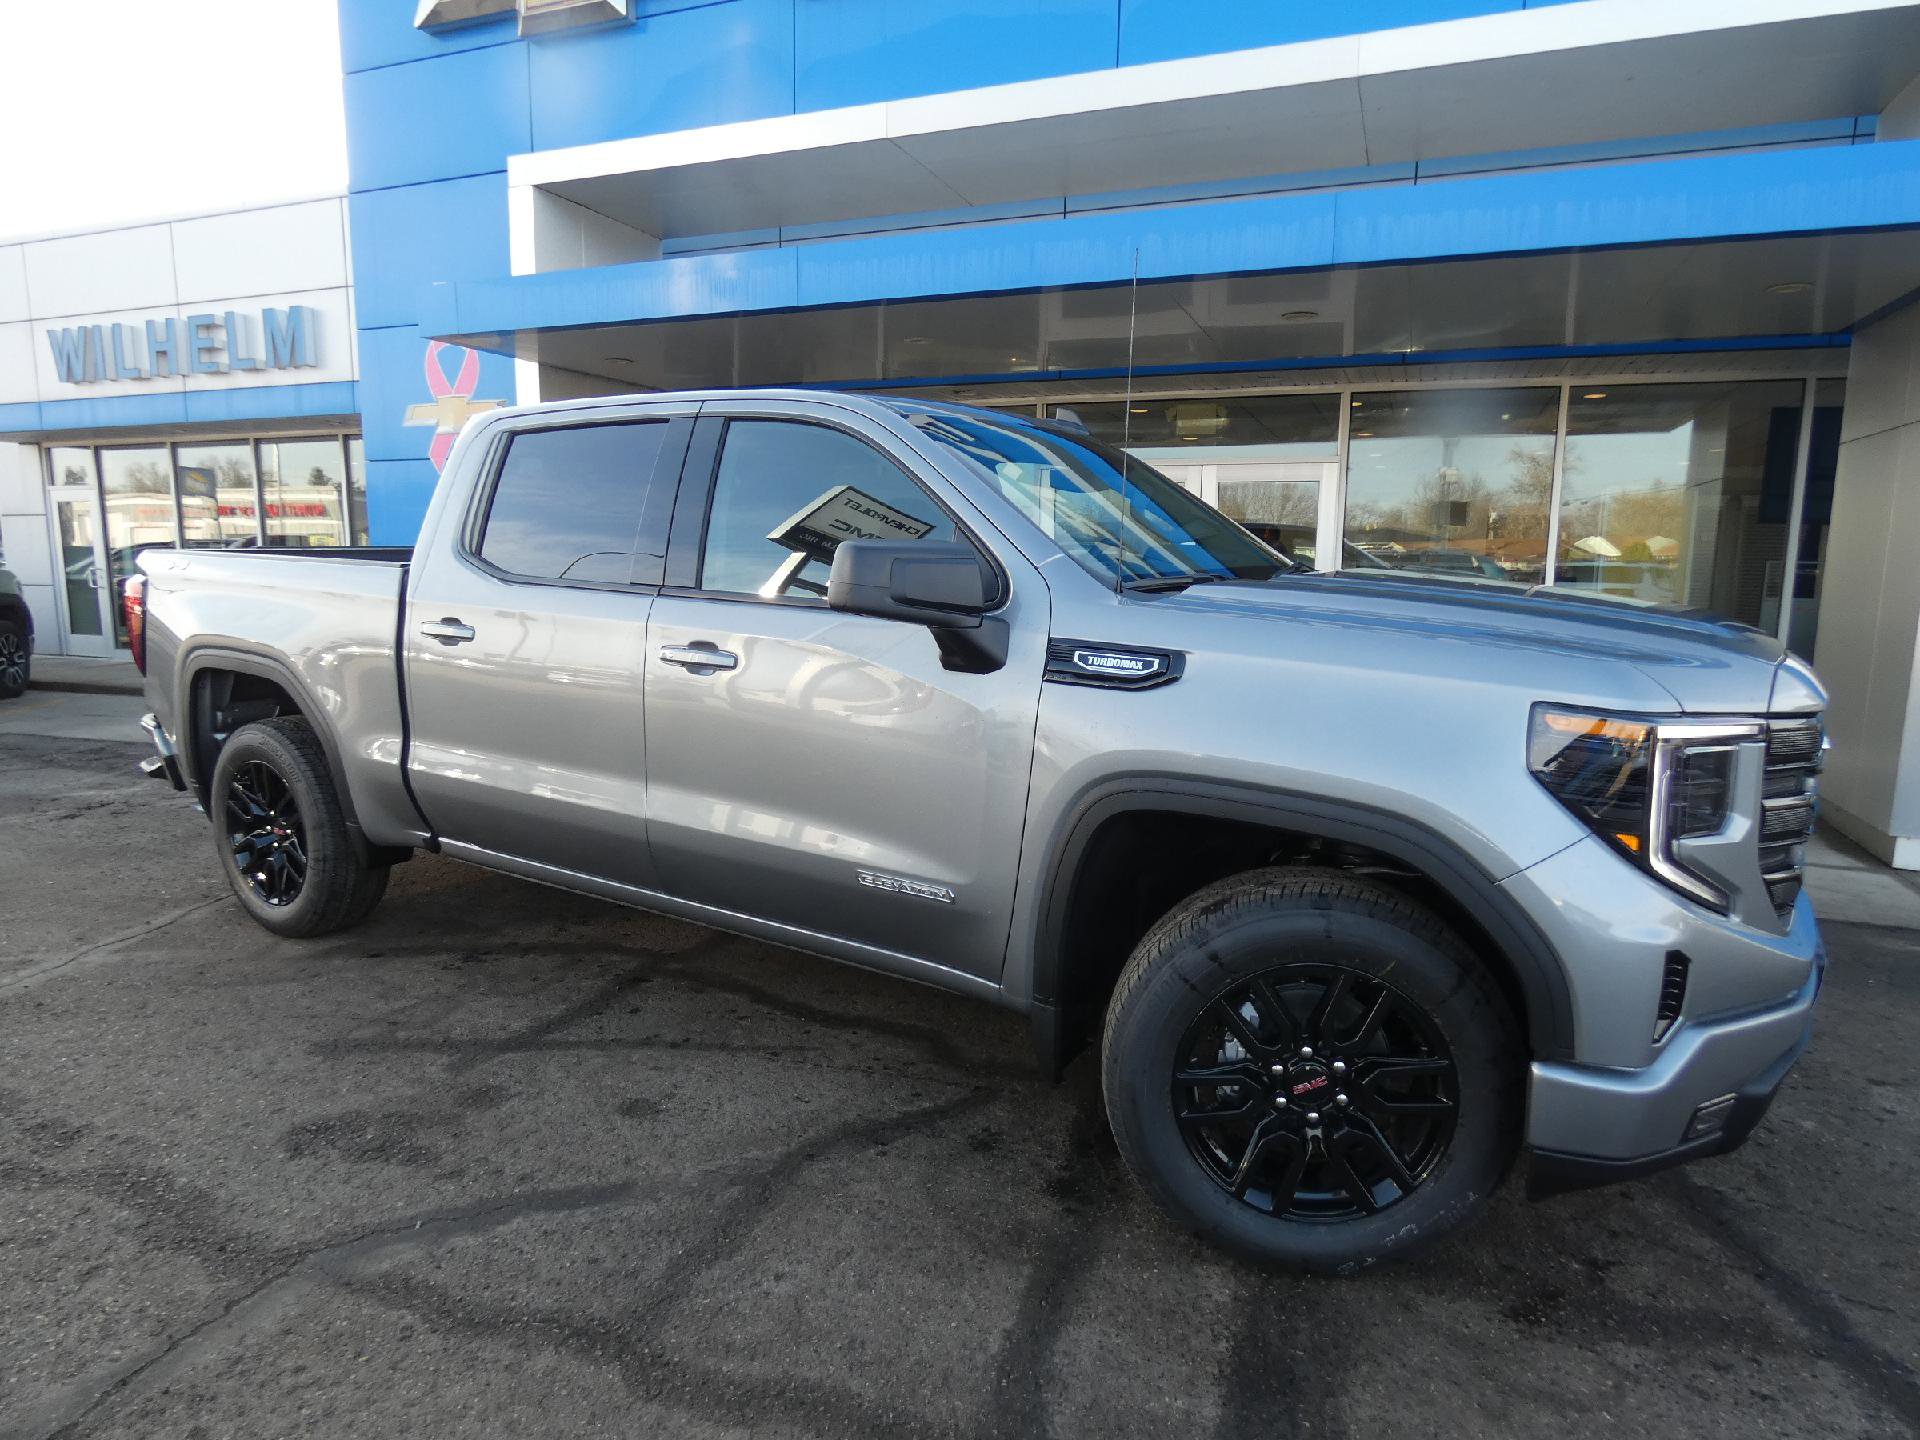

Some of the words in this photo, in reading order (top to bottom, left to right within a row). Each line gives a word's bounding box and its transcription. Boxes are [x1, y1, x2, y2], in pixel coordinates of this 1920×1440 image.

[47, 305, 316, 383] WILHELM
[1088, 656, 1143, 669] TURBOMAX
[1292, 1076, 1328, 1094] GMC
